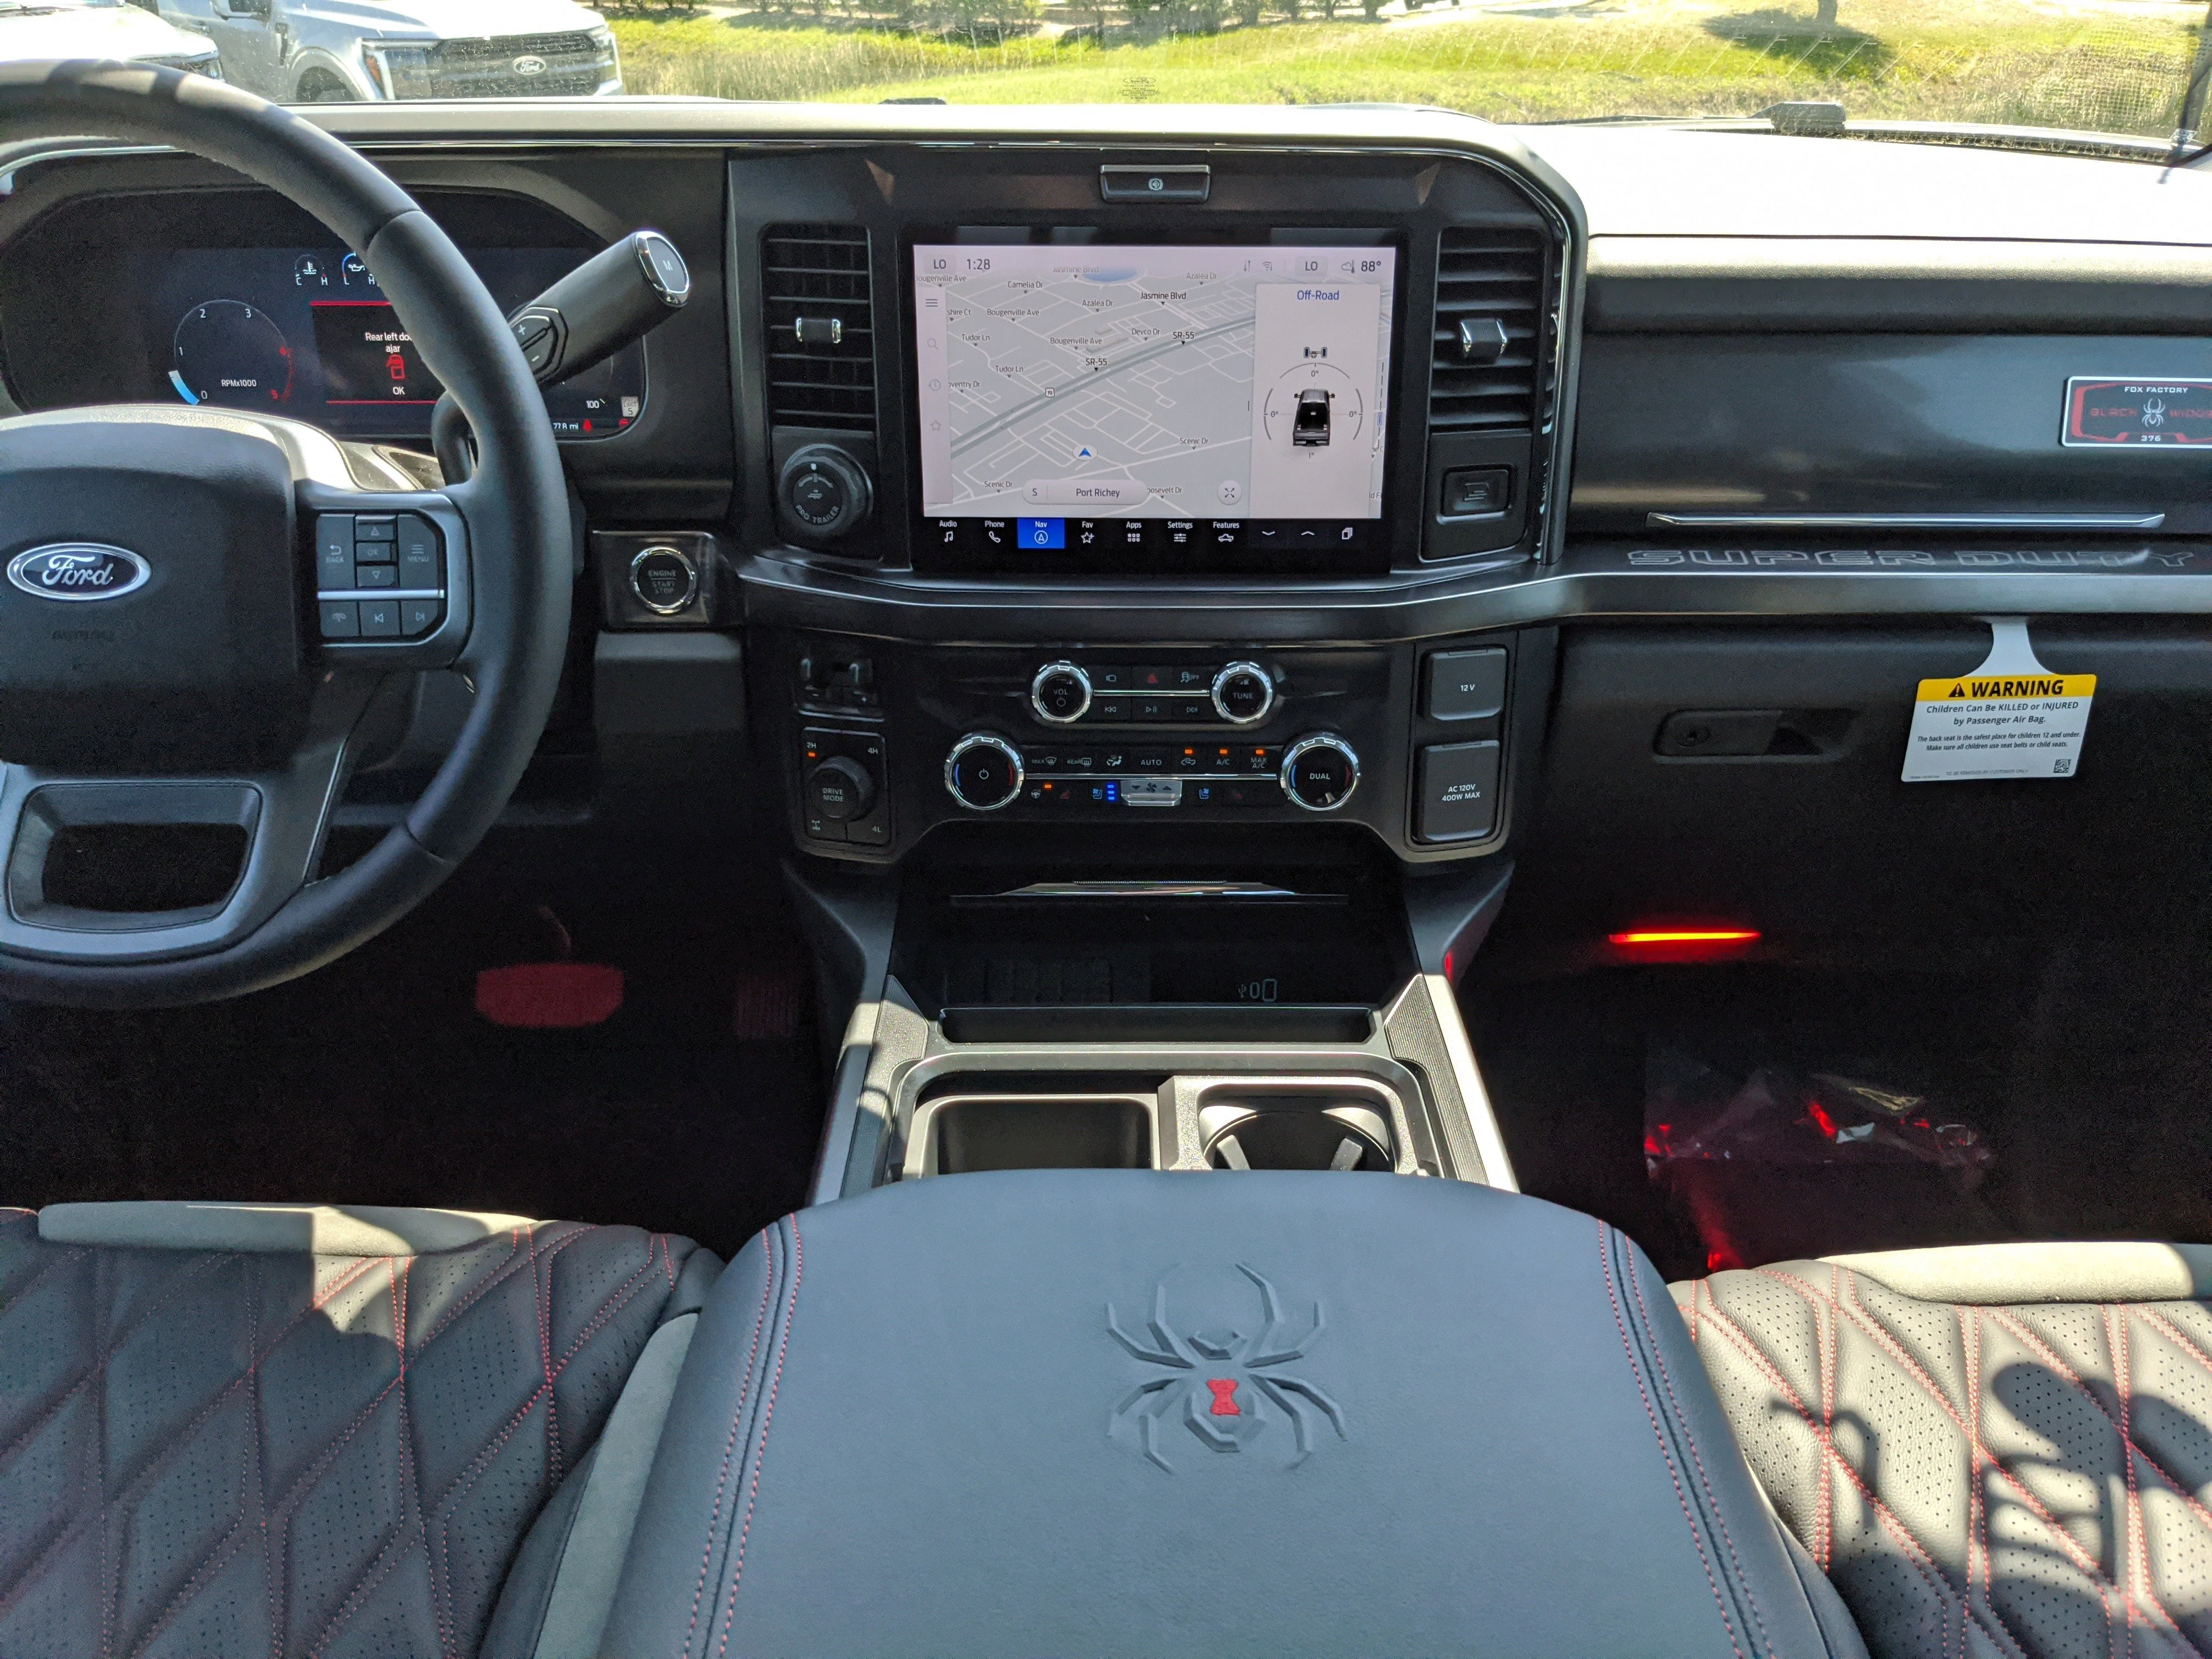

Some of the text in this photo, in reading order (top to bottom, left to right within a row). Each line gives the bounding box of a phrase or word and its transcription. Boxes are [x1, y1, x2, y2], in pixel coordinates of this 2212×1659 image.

[520, 61, 540, 72] Ford
[933, 259, 947, 269] LO
[966, 259, 991, 270] 1:28
[1305, 261, 1318, 271] LO
[1361, 261, 1381, 272] 88°
[321, 278, 328, 286] H
[368, 276, 375, 285] H
[1297, 290, 1339, 300] Off-Road
[200, 309, 206, 318] 2
[245, 308, 251, 318] 3
[987, 309, 1025, 318] Bougenville
[365, 332, 383, 341] Rear
[384, 332, 398, 341] left
[1172, 331, 1194, 340] SR-55
[178, 347, 183, 356] 1
[385, 344, 400, 354] ajar
[201, 391, 208, 399] 0
[393, 386, 405, 395] OK
[586, 400, 600, 409] 100
[1032, 488, 1037, 496] S
[1076, 488, 1120, 499] Port Richey
[795, 504, 839, 524] PRO TRAILER
[1167, 521, 1193, 529] Settings
[1627, 550, 2194, 567] SUPER DUTY
[42, 554, 114, 586] Ford
[1971, 680, 2064, 698] WARNING
[1926, 705, 1963, 713] Children
[1998, 703, 2029, 711] KILLED
[2042, 701, 2079, 712] INJURED
[1954, 717, 1964, 726] by
[1966, 717, 2011, 726] Passenger
[2028, 715, 2046, 724] Bag.
[823, 787, 844, 795] DRIVE
[1459, 784, 1476, 792] 120V
[1442, 793, 1463, 802] 400W
